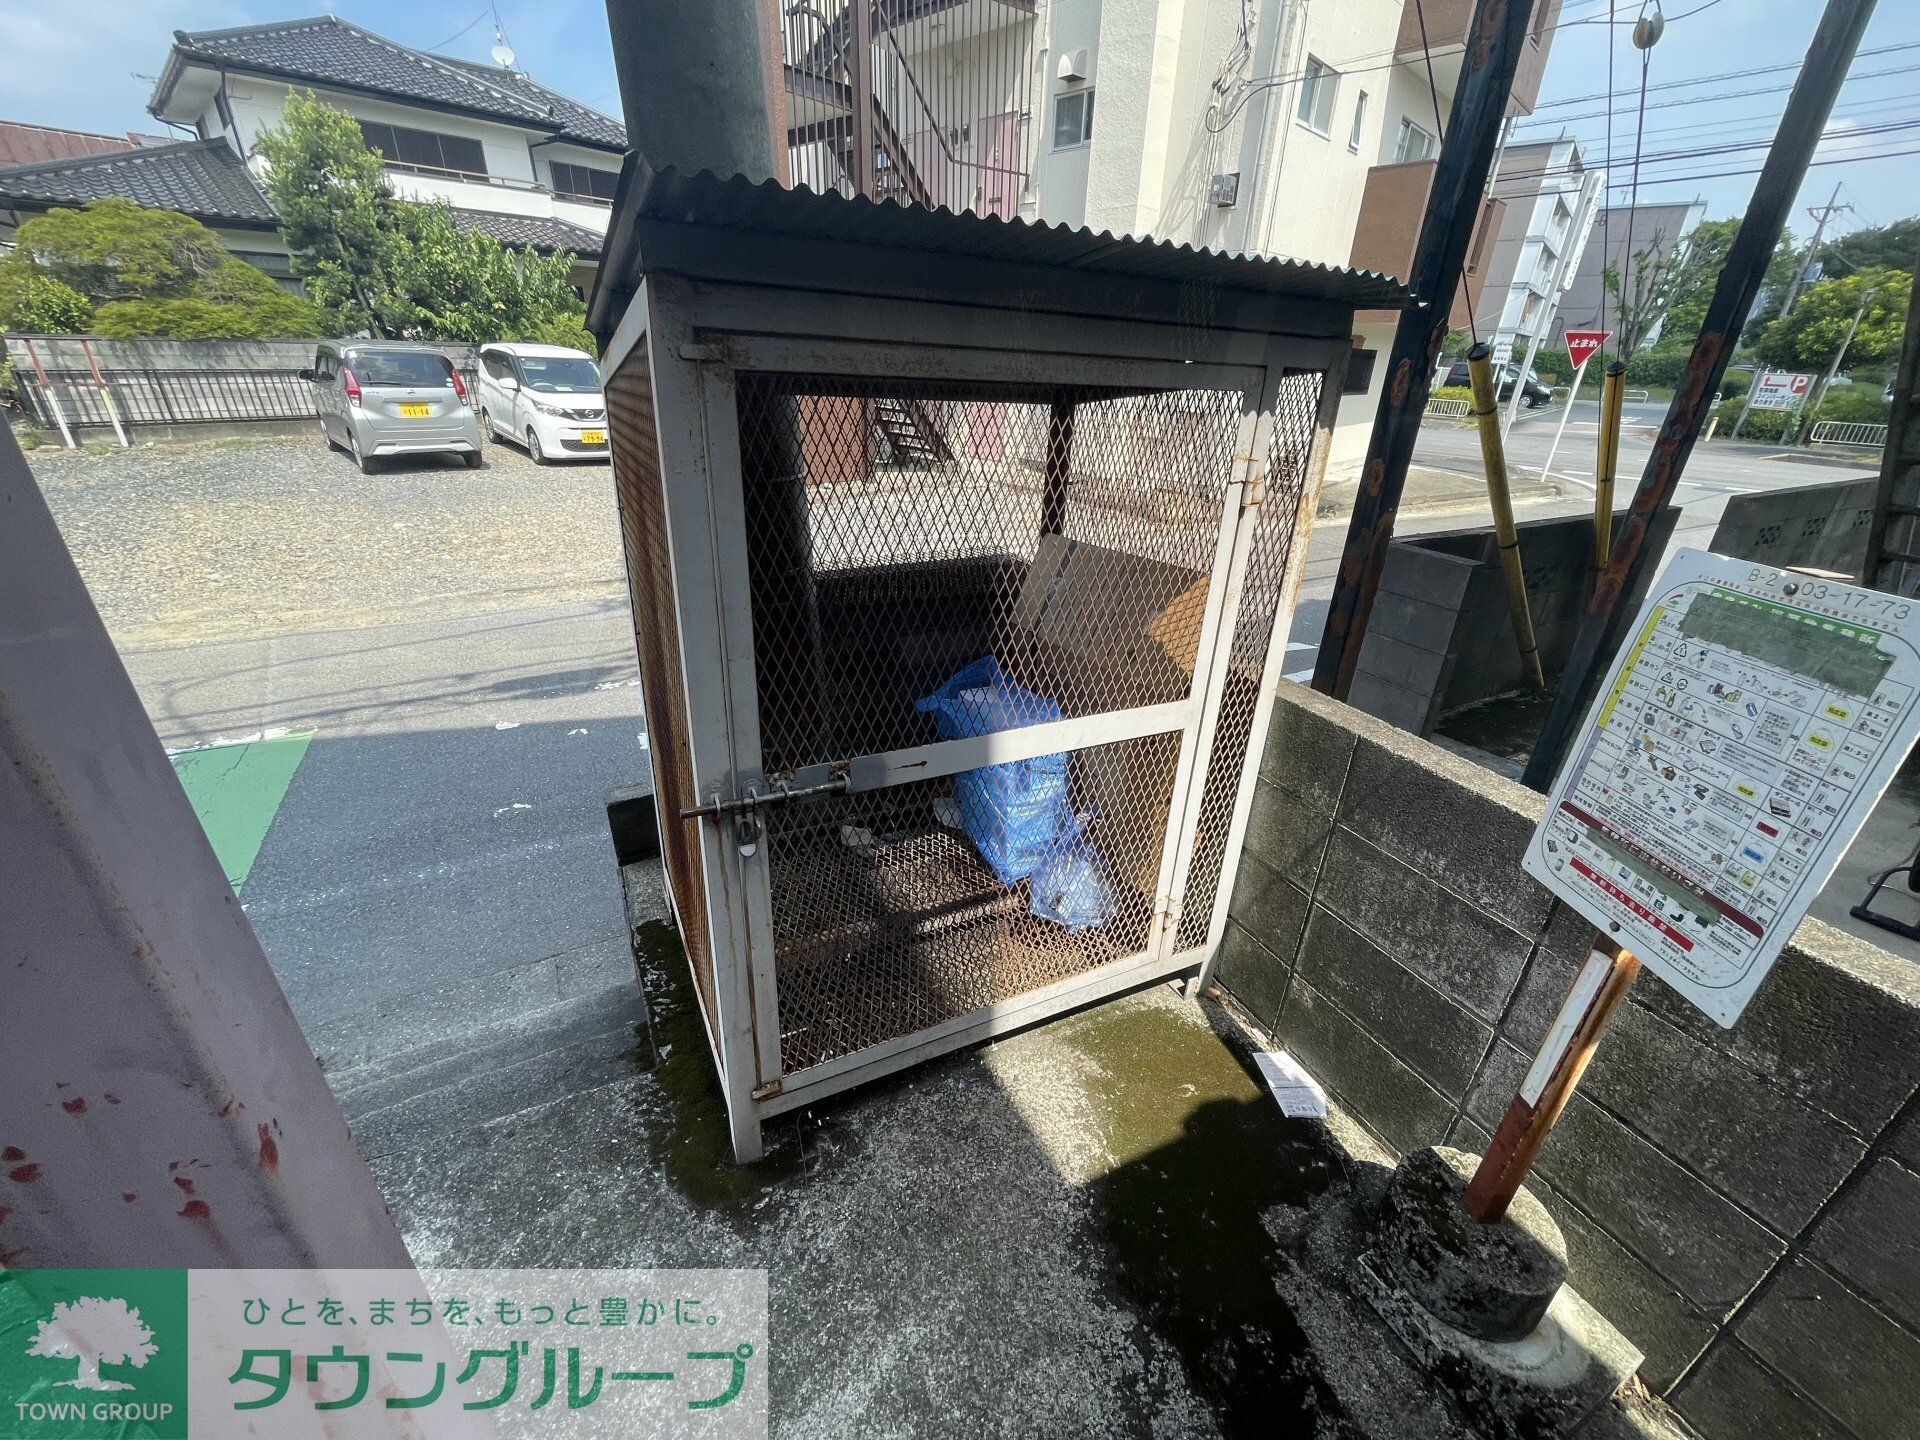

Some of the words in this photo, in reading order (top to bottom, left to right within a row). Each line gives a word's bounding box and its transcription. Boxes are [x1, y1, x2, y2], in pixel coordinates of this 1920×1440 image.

[1569, 338, 1598, 348] 止まれ
[1792, 376, 1809, 391] P
[1748, 568, 1778, 587] B-2
[1801, 581, 1912, 620] 03-17-73
